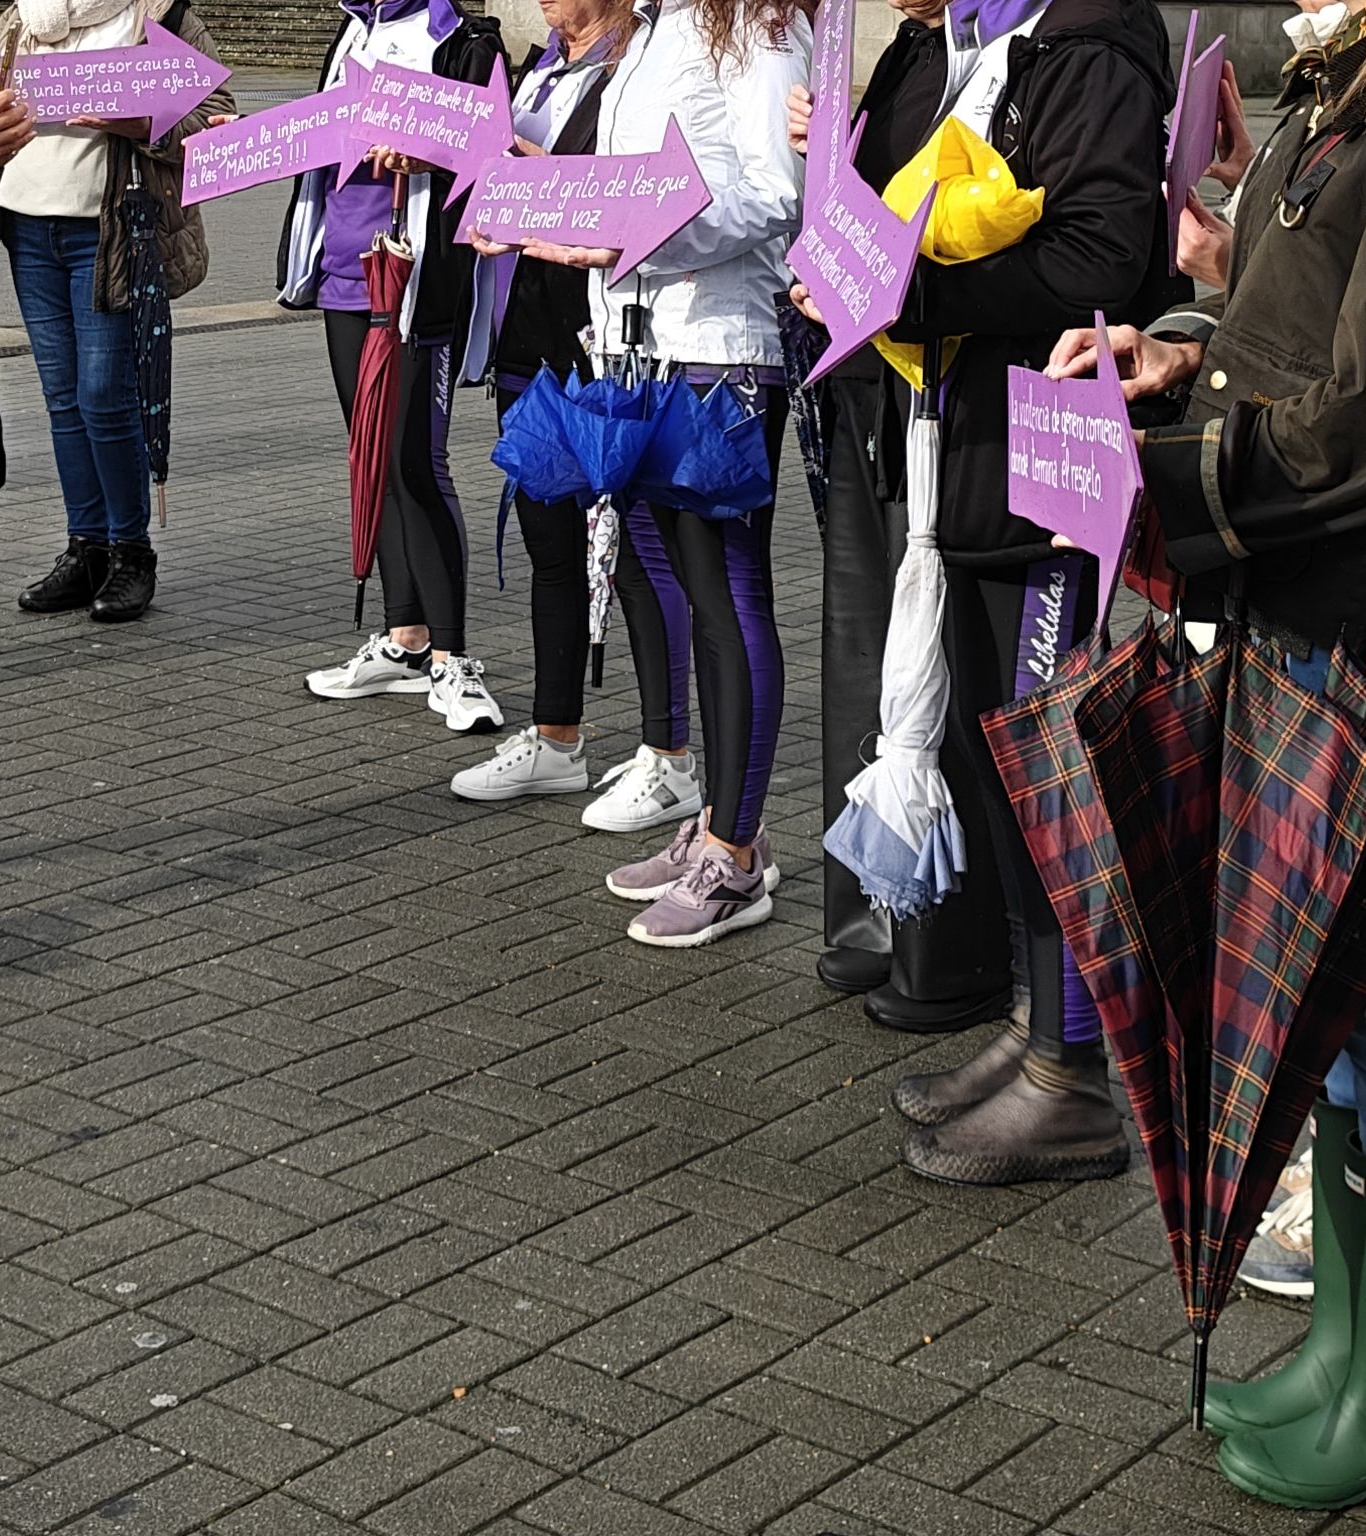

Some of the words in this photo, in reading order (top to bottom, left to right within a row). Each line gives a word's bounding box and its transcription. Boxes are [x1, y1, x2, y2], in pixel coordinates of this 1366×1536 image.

[13, 67, 41, 87] que
[47, 65, 69, 79] un
[75, 61, 132, 81] agresor
[136, 57, 180, 72] causa
[184, 57, 196, 69] a
[34, 83, 64, 98] una
[70, 79, 123, 96] herida
[131, 77, 157, 98] que
[162, 71, 212, 95] afecta
[37, 97, 125, 117] sociedad.
[371, 73, 384, 94] El
[383, 80, 406, 98] amor
[473, 100, 495, 128] que
[192, 139, 241, 170] Proteger
[245, 136, 255, 149] a
[260, 124, 272, 146] la
[277, 110, 329, 143] infancia
[336, 105, 349, 120] es
[361, 100, 389, 128] duele
[389, 114, 403, 132] es
[403, 106, 415, 136] la
[418, 116, 469, 151] violencia.
[190, 175, 198, 188] a
[201, 166, 218, 186] las
[226, 146, 282, 180] MADRES
[481, 171, 533, 201] Somos
[538, 170, 561, 200] el
[557, 164, 600, 209] grito
[603, 163, 627, 197] de
[629, 164, 655, 197] las
[656, 174, 690, 208] que
[476, 207, 491, 234] ya
[496, 207, 513, 225] no
[518, 203, 564, 229] tienen
[571, 209, 603, 231] voz.
[1019, 382, 1050, 433] violencia
[1052, 394, 1060, 434] de
[1061, 403, 1084, 447] género
[1086, 411, 1123, 455] comienza
[1011, 438, 1029, 478] donde
[1031, 436, 1058, 489] termina
[1061, 447, 1070, 490] el
[1070, 449, 1104, 513] respeto.
